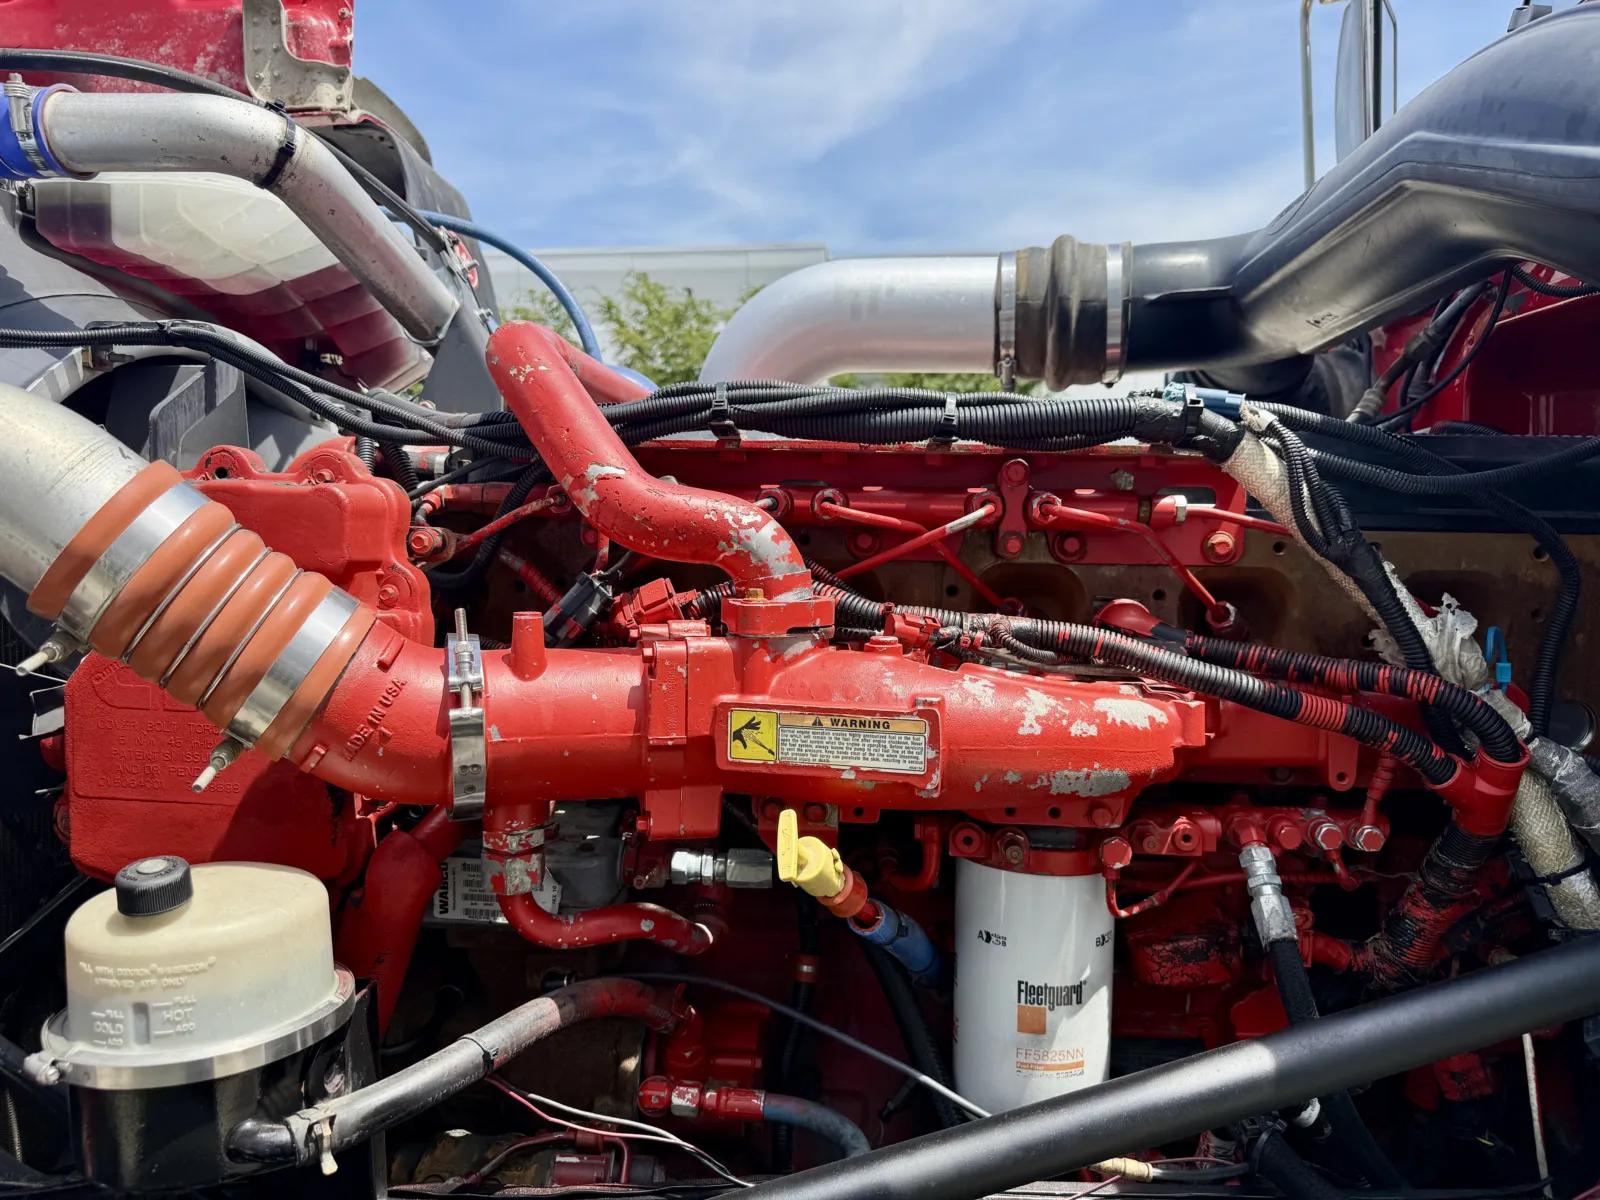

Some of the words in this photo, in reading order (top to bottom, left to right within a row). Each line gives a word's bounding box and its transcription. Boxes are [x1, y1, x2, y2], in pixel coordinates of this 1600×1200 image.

[367, 704, 387, 727] IN
[378, 677, 408, 708] USA
[830, 717, 891, 730] WARNING
[977, 929, 985, 941] A
[1017, 979, 1083, 1012] Fleetguard
[163, 1007, 193, 1022] HOT
[93, 1020, 125, 1035] COLD
[1015, 1047, 1084, 1062] FF5825NN
